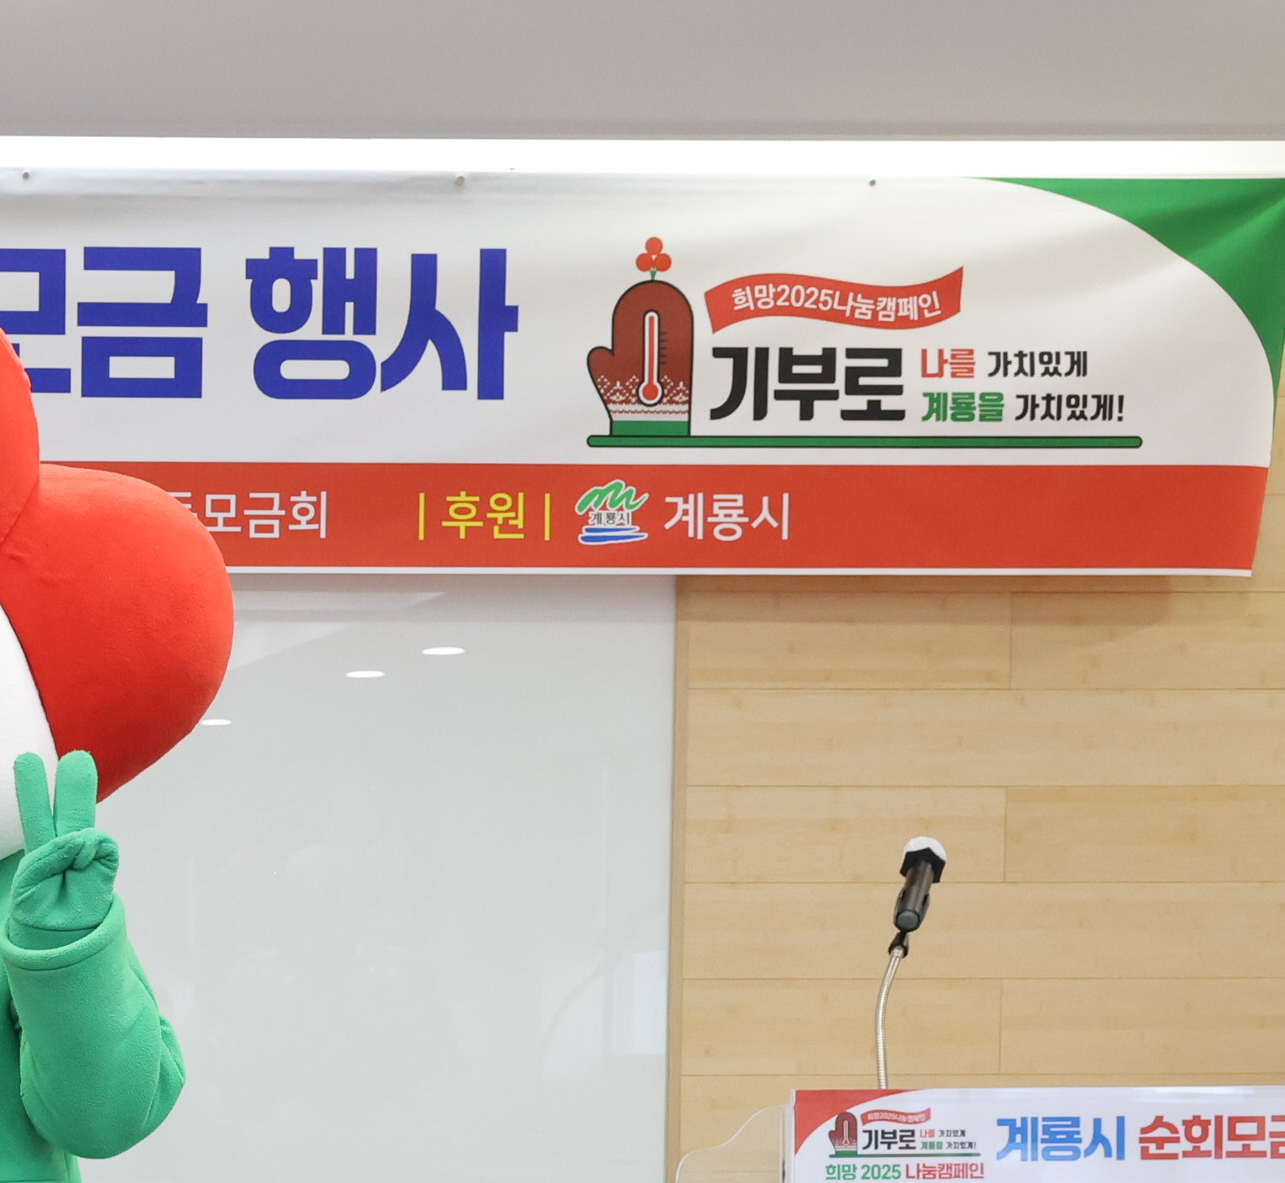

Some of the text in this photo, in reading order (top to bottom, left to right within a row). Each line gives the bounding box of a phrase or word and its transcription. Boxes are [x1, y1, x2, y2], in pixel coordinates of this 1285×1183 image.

[732, 284, 942, 322] 희망2025나눔캠페인
[245, 246, 519, 400] 행사
[709, 346, 1088, 422] 기부로 나를 가치있게
[921, 391, 1125, 423] 계룡을 가치있게!
[167, 490, 327, 539] 모금회
[664, 492, 790, 541] 계룡시
[590, 511, 631, 525] 계룡시
[862, 1129, 917, 1150] 기부로
[995, 1115, 1126, 1161] 계룡시
[825, 1162, 985, 1181] 희망 2025 나눔캠페인
